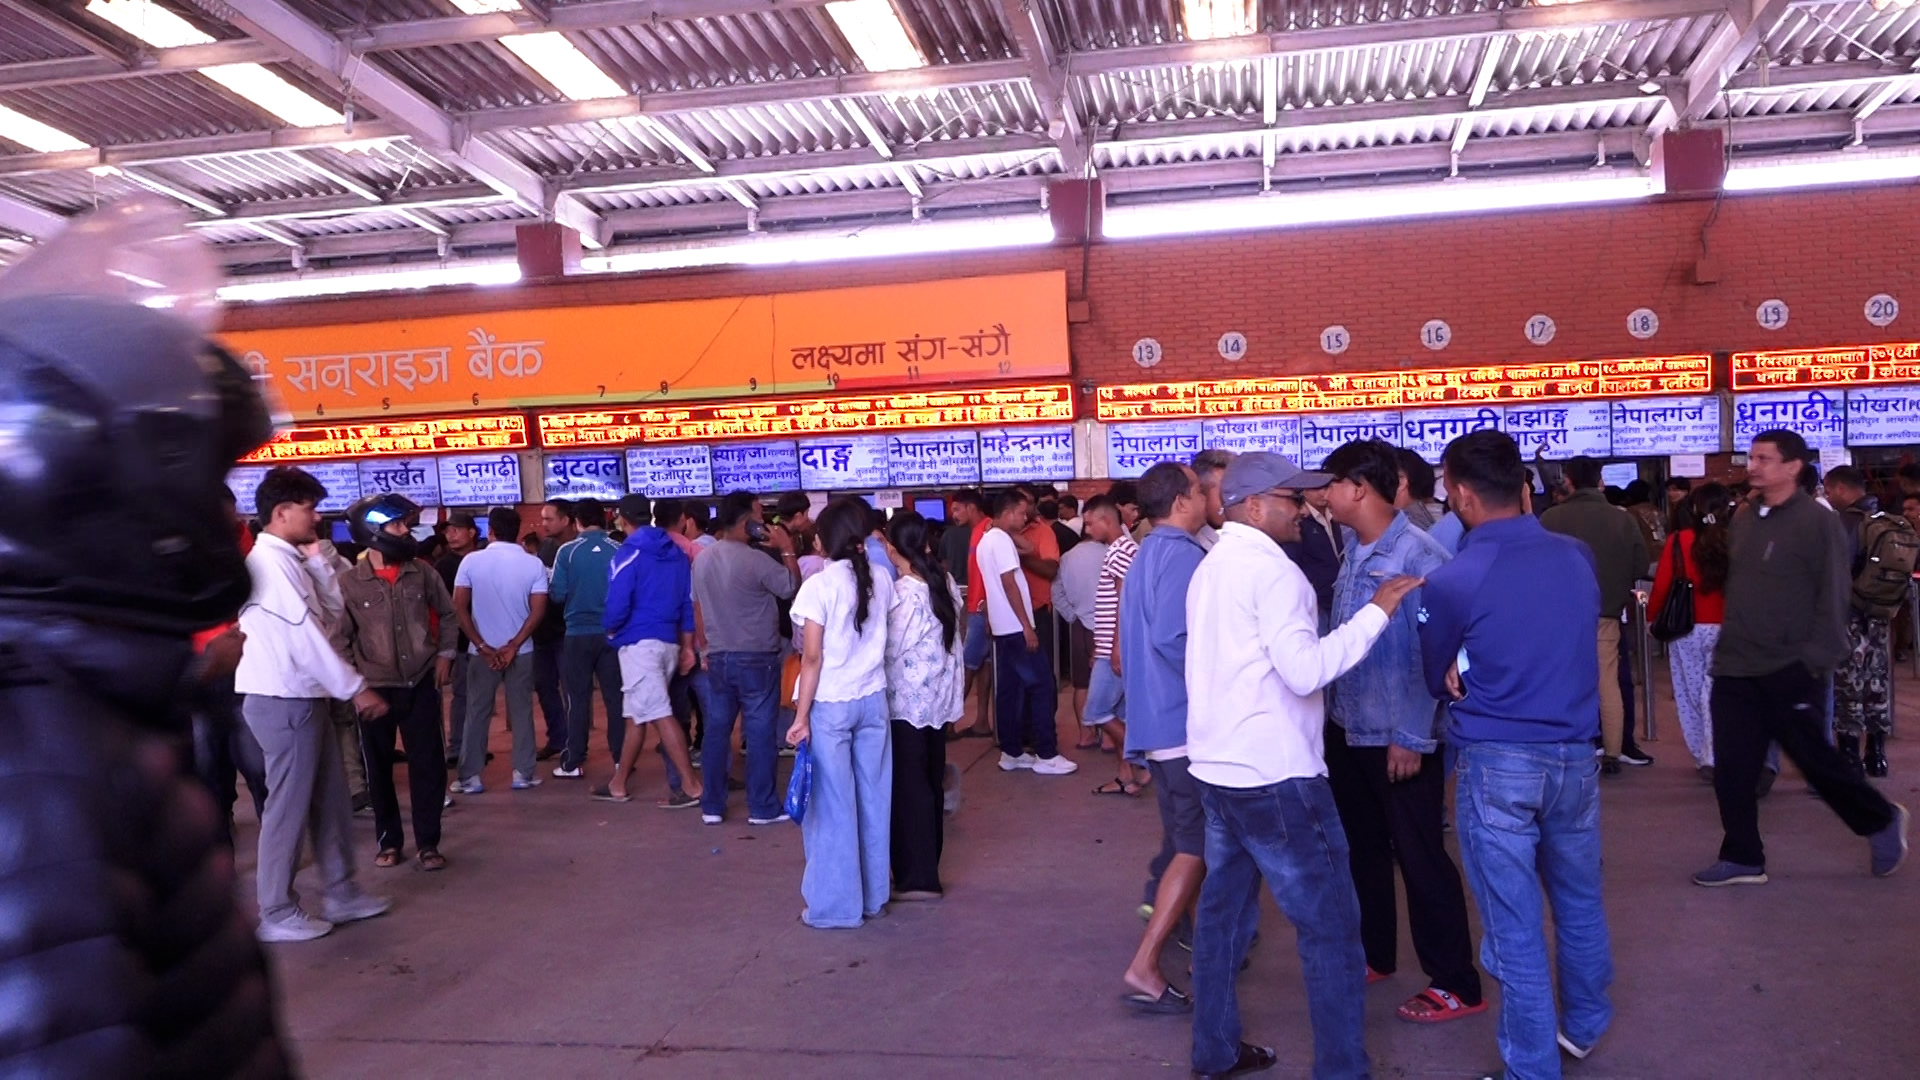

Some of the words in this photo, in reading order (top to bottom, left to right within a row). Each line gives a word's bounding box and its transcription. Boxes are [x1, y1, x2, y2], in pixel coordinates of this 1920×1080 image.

[1763, 307, 1781, 324] 19
[1871, 300, 1894, 318] 20
[1529, 321, 1546, 338] 17
[1632, 316, 1649, 332] 18
[1326, 333, 1343, 349] 15
[1426, 327, 1444, 343] 16
[466, 327, 545, 380] बैंक
[1138, 345, 1155, 362] 13
[1223, 339, 1241, 354] 14
[907, 366, 920, 380] 11
[997, 361, 1012, 374] 12
[749, 377, 757, 391] 9
[826, 373, 840, 386] 10
[597, 385, 606, 398] 7
[660, 380, 669, 396] 8
[382, 397, 391, 411] 5
[472, 392, 480, 406] 6
[1737, 390, 1834, 422] धनगढी
[1848, 393, 1908, 413] पोखरा
[1611, 403, 1704, 424] नेपालगंज
[1303, 420, 1402, 443] नेपालगंज
[1734, 418, 1790, 434] टिकापर
[889, 436, 976, 458] नेपालगंज
[981, 429, 1071, 454] महेन्द्रनगर
[455, 454, 517, 478] धनगढी
[550, 457, 622, 486] बुटवल
[372, 461, 426, 493] सुर्खेत
[649, 469, 693, 484] राजापुर
